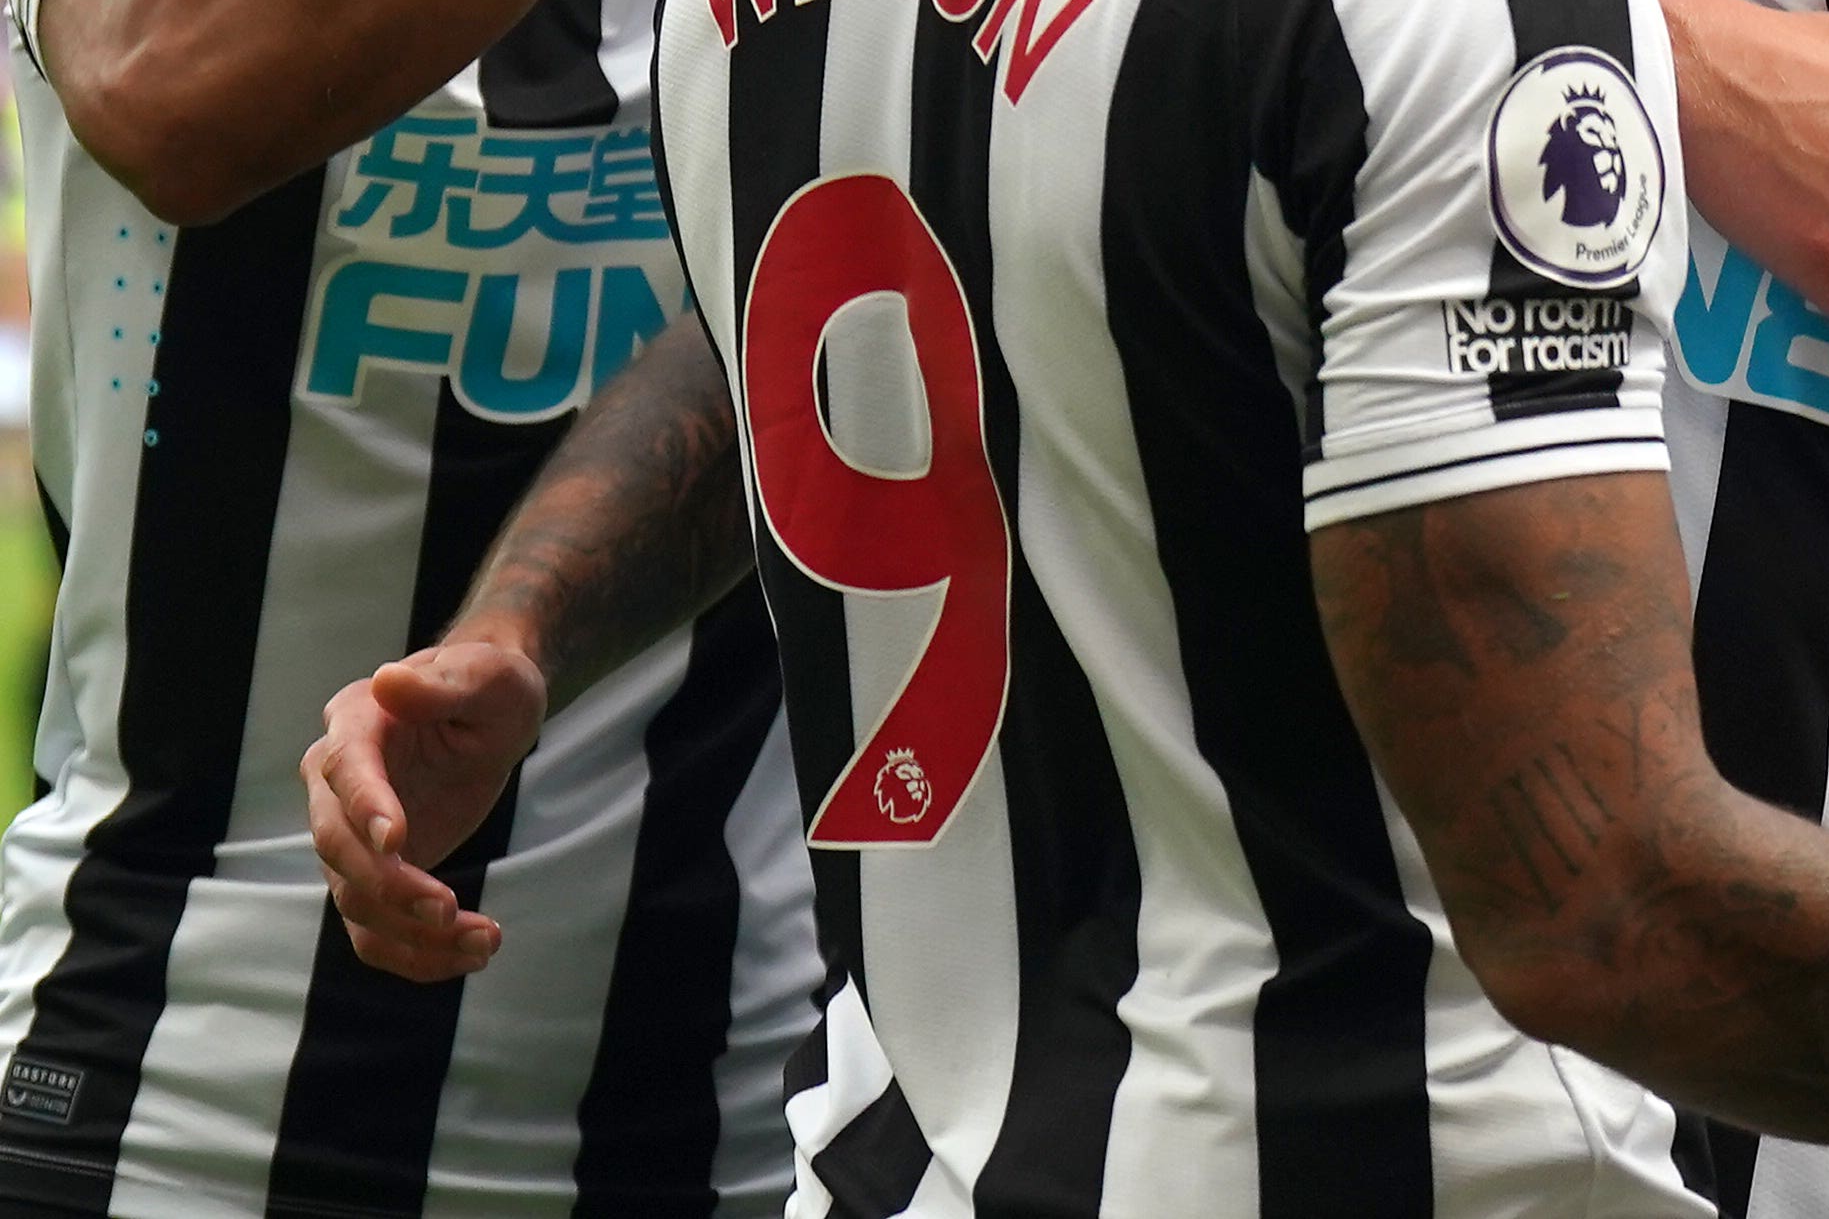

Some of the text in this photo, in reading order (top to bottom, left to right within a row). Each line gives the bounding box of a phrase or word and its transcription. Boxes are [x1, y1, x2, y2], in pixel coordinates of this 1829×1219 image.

[1576, 234, 1629, 261] Premier
[1447, 298, 1622, 334] No room
[1449, 330, 1631, 374] for racism
[742, 173, 1012, 849] 9
